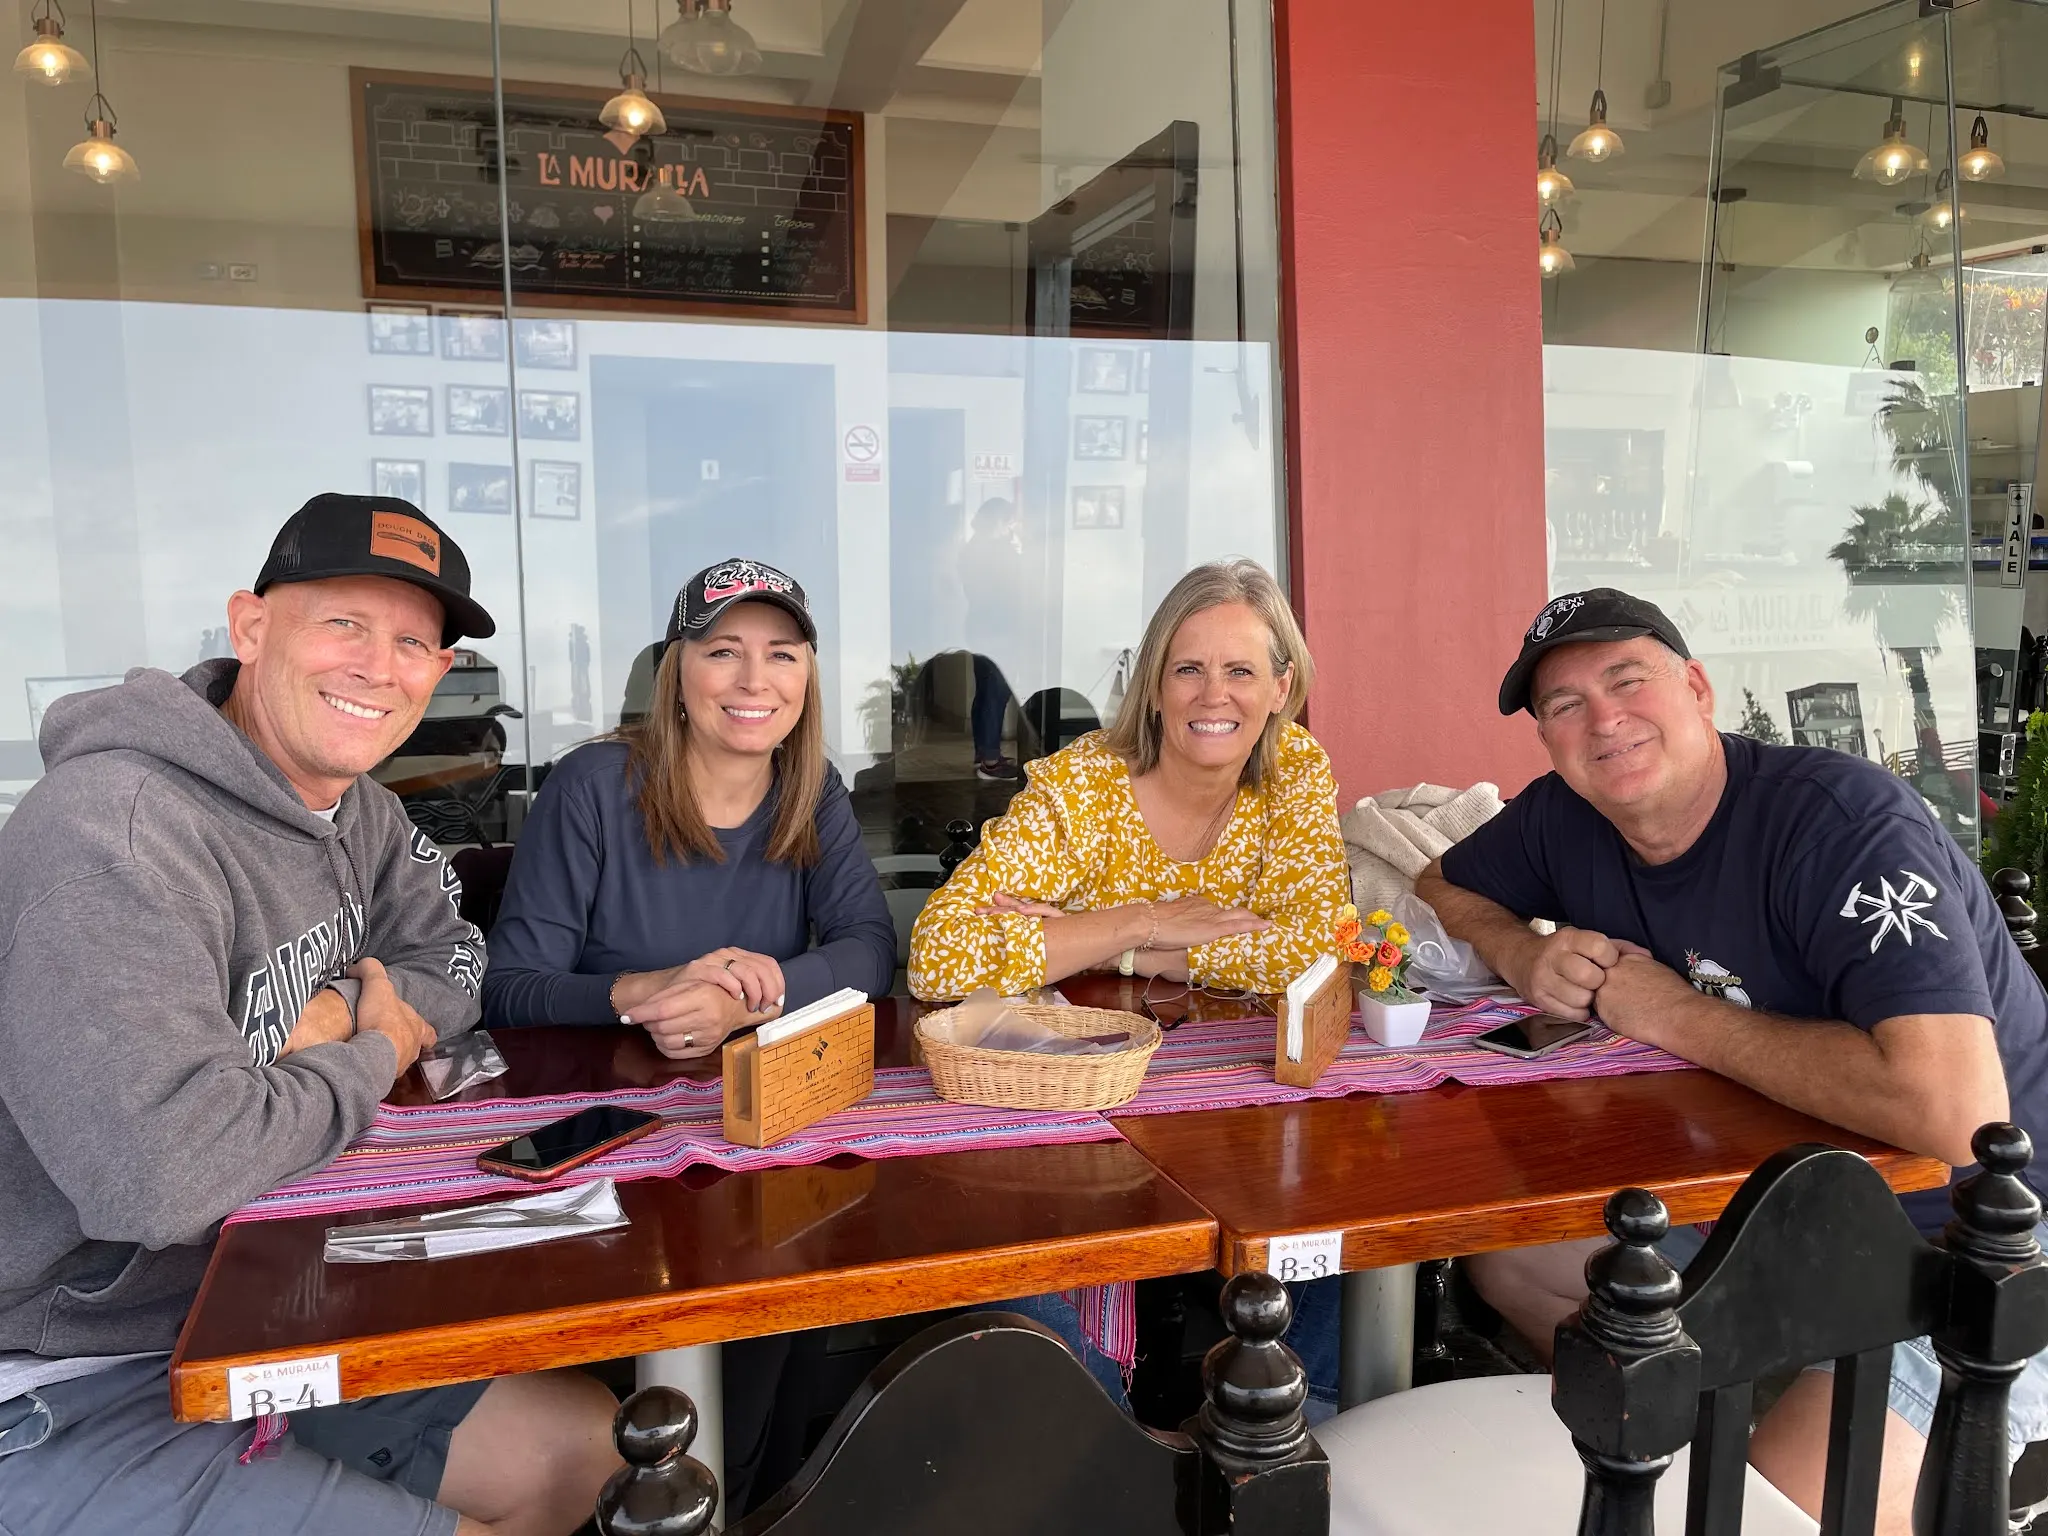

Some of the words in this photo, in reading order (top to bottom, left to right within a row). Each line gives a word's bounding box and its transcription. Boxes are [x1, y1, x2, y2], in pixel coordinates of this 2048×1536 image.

[537, 152, 561, 185] LA
[377, 522, 412, 535] DOUGH
[2007, 513, 2021, 573] JALE
[1556, 601, 1585, 615] PLAN
[1279, 1253, 1328, 1281] B-3
[277, 1361, 331, 1377] MURALLA
[247, 1383, 323, 1417] B-4
